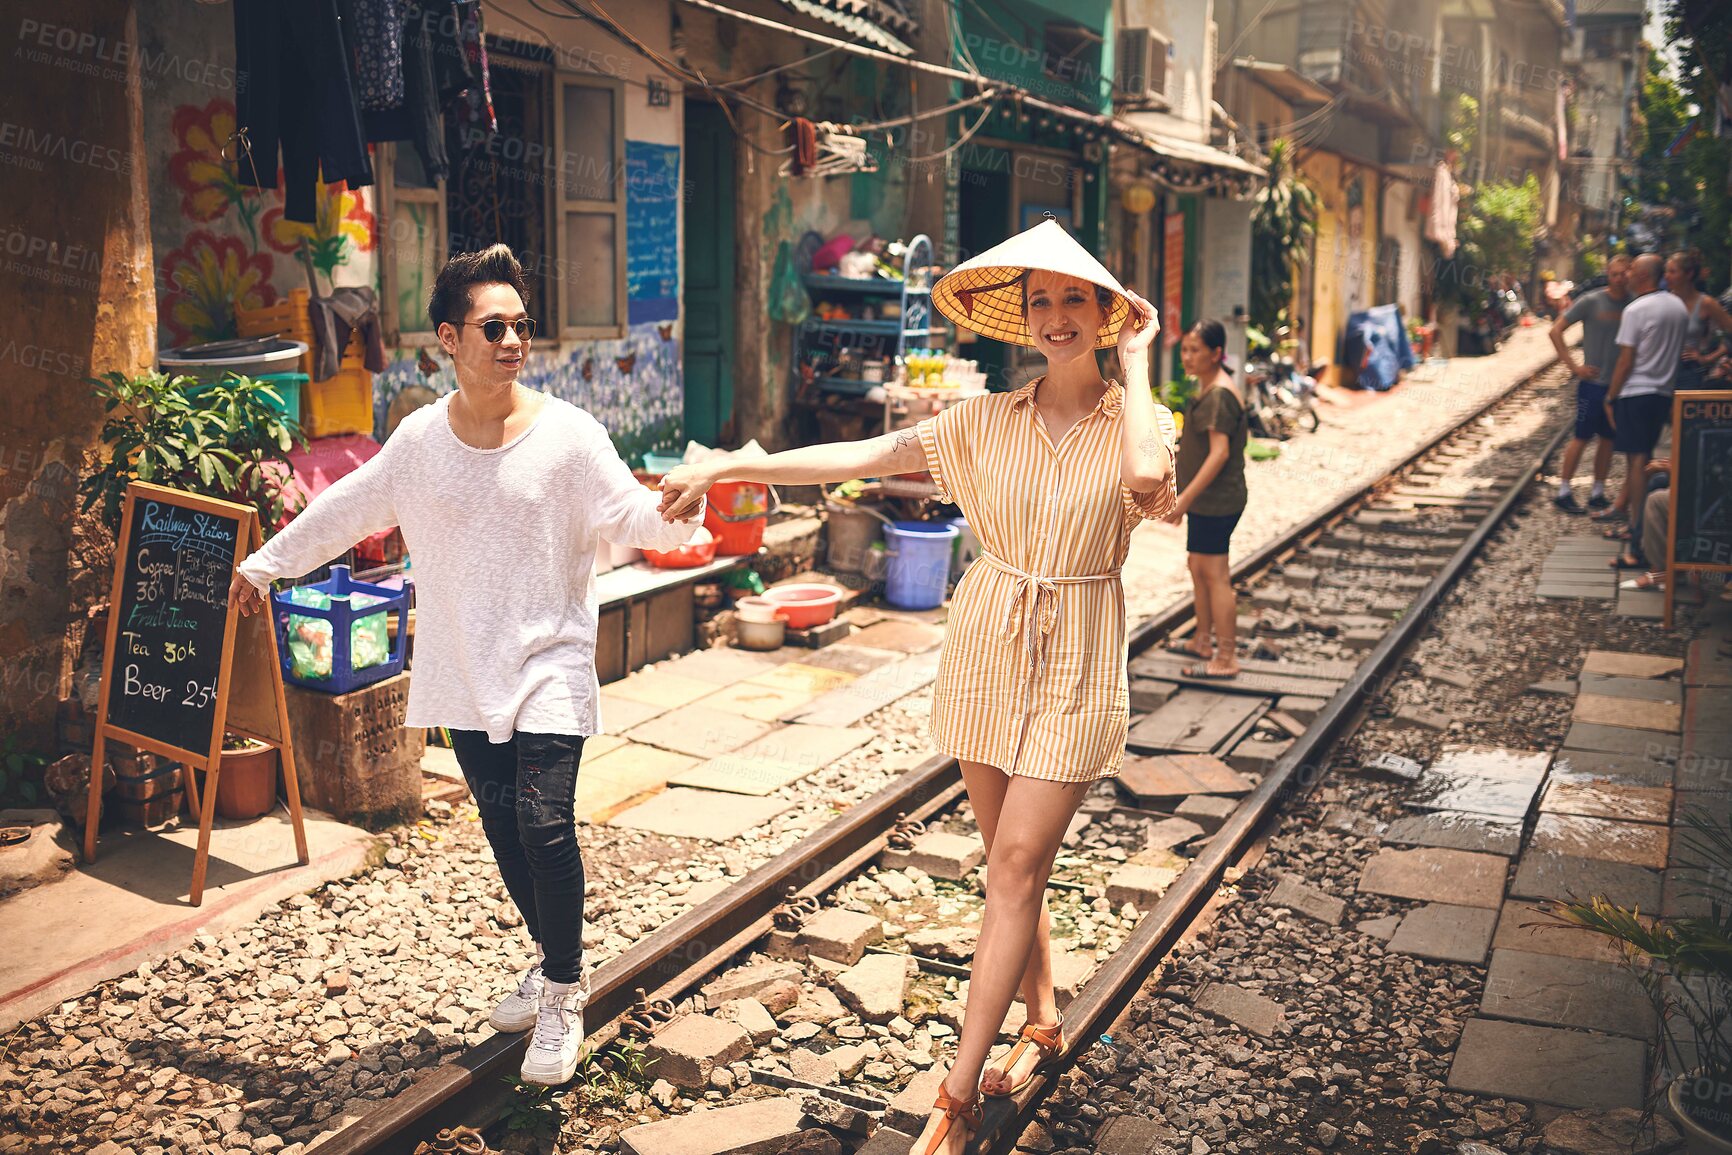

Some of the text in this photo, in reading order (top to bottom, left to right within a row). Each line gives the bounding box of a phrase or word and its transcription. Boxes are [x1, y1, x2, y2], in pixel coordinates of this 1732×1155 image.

[141, 502, 233, 551] Railway Station
[137, 549, 175, 585] Coffee
[122, 631, 196, 663] Tea 30k
[124, 663, 218, 708] Beer 25k
